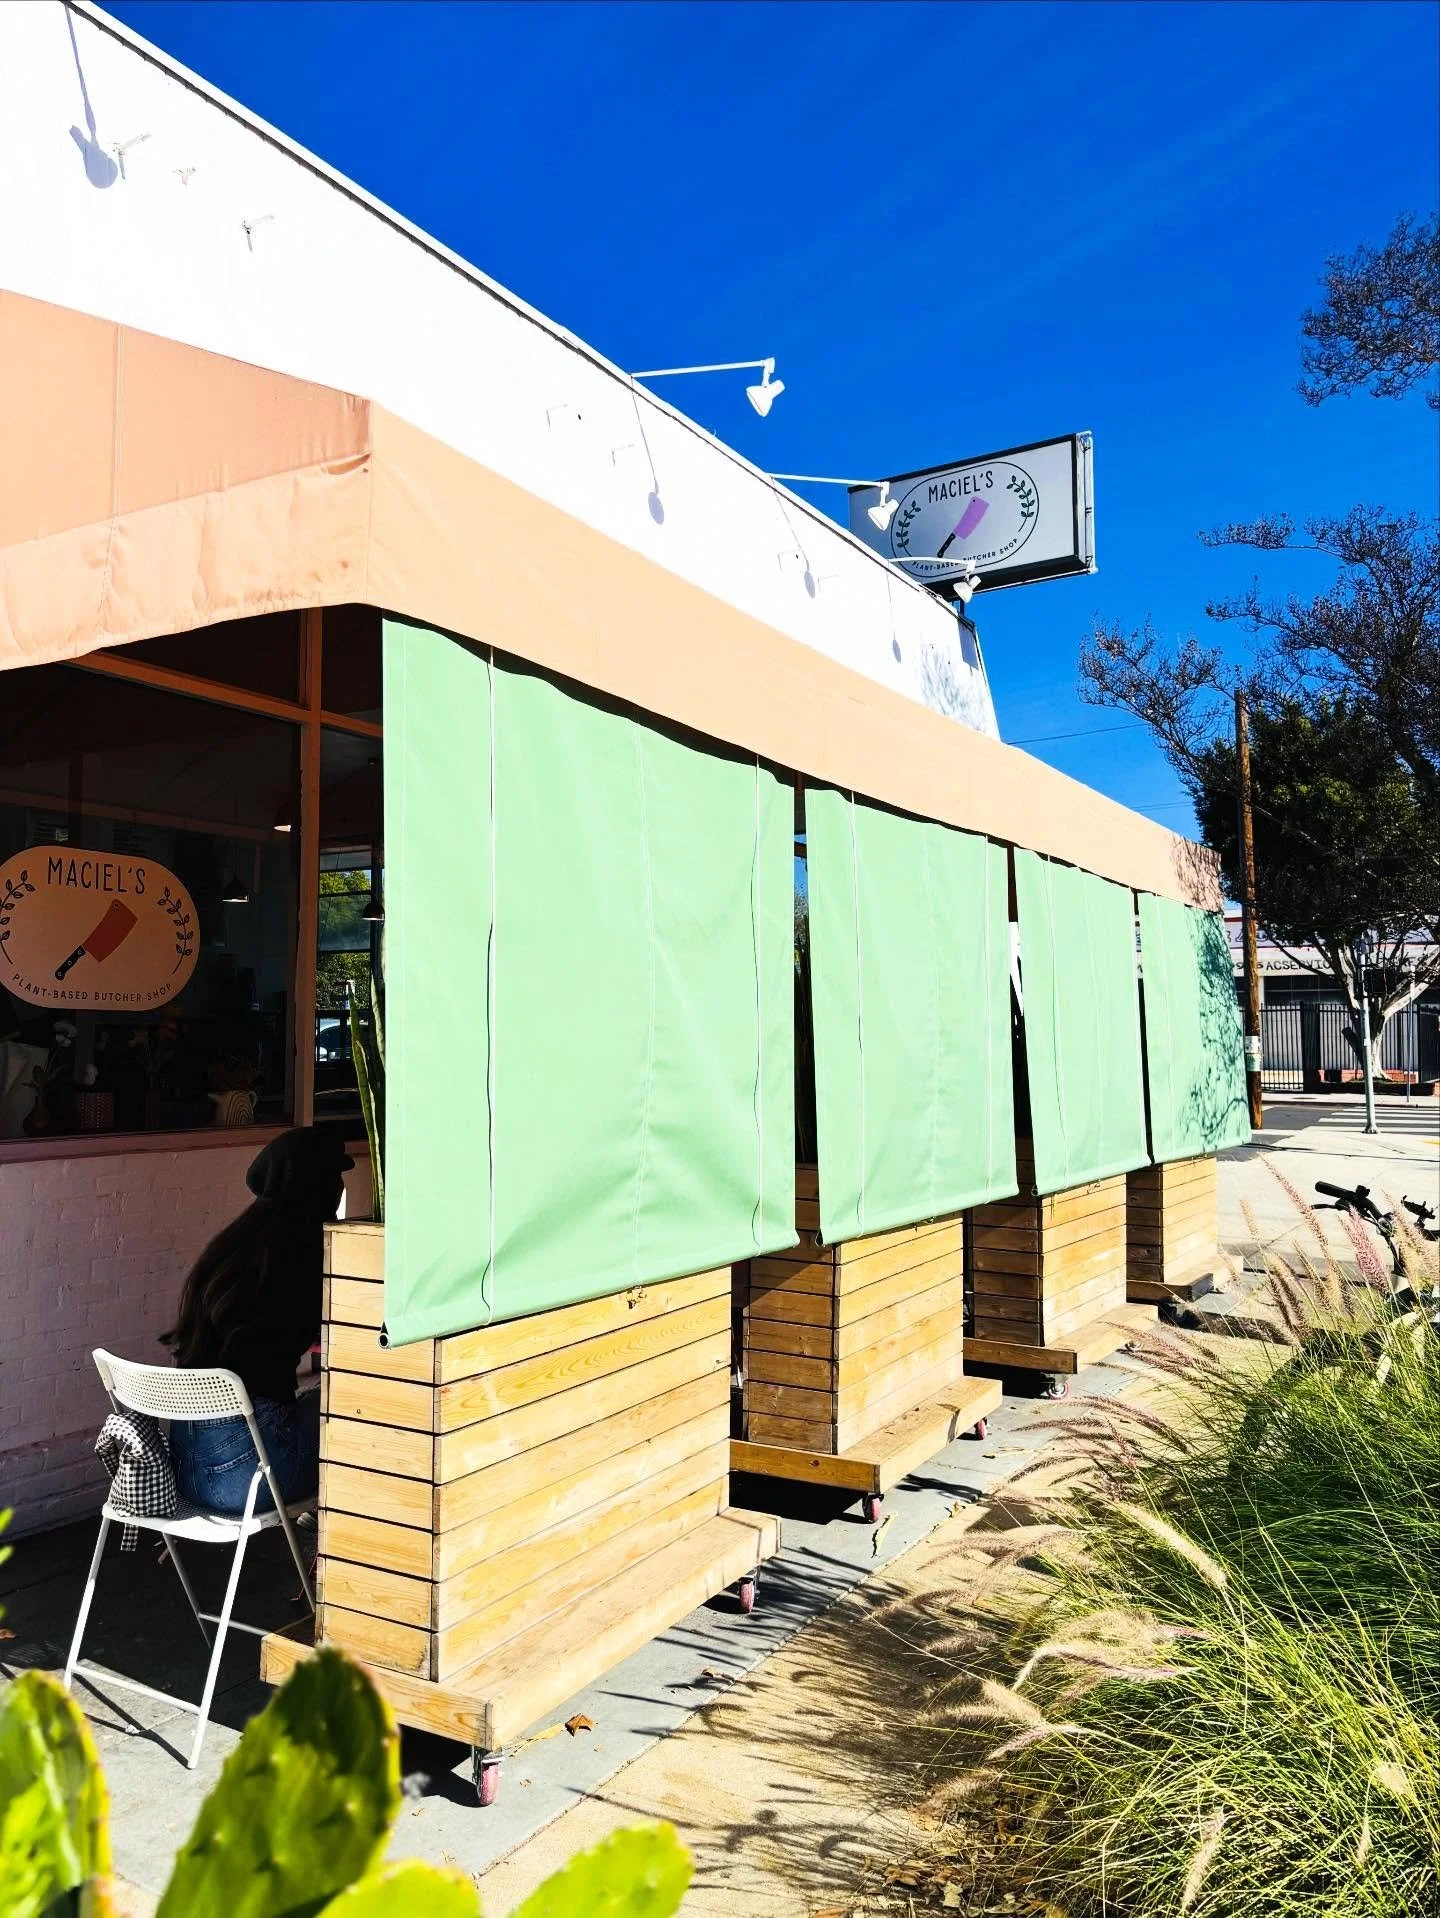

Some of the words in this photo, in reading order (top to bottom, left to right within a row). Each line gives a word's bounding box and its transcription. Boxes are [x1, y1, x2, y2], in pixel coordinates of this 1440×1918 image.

[928, 470, 994, 503] MACIEL'S
[1000, 538, 1018, 555] SHOP
[47, 856, 146, 895] MACIEL'S
[12, 973, 88, 1000] PLANT-BASED
[94, 991, 142, 1002] BUTCHER
[147, 983, 172, 1001] SHOP
